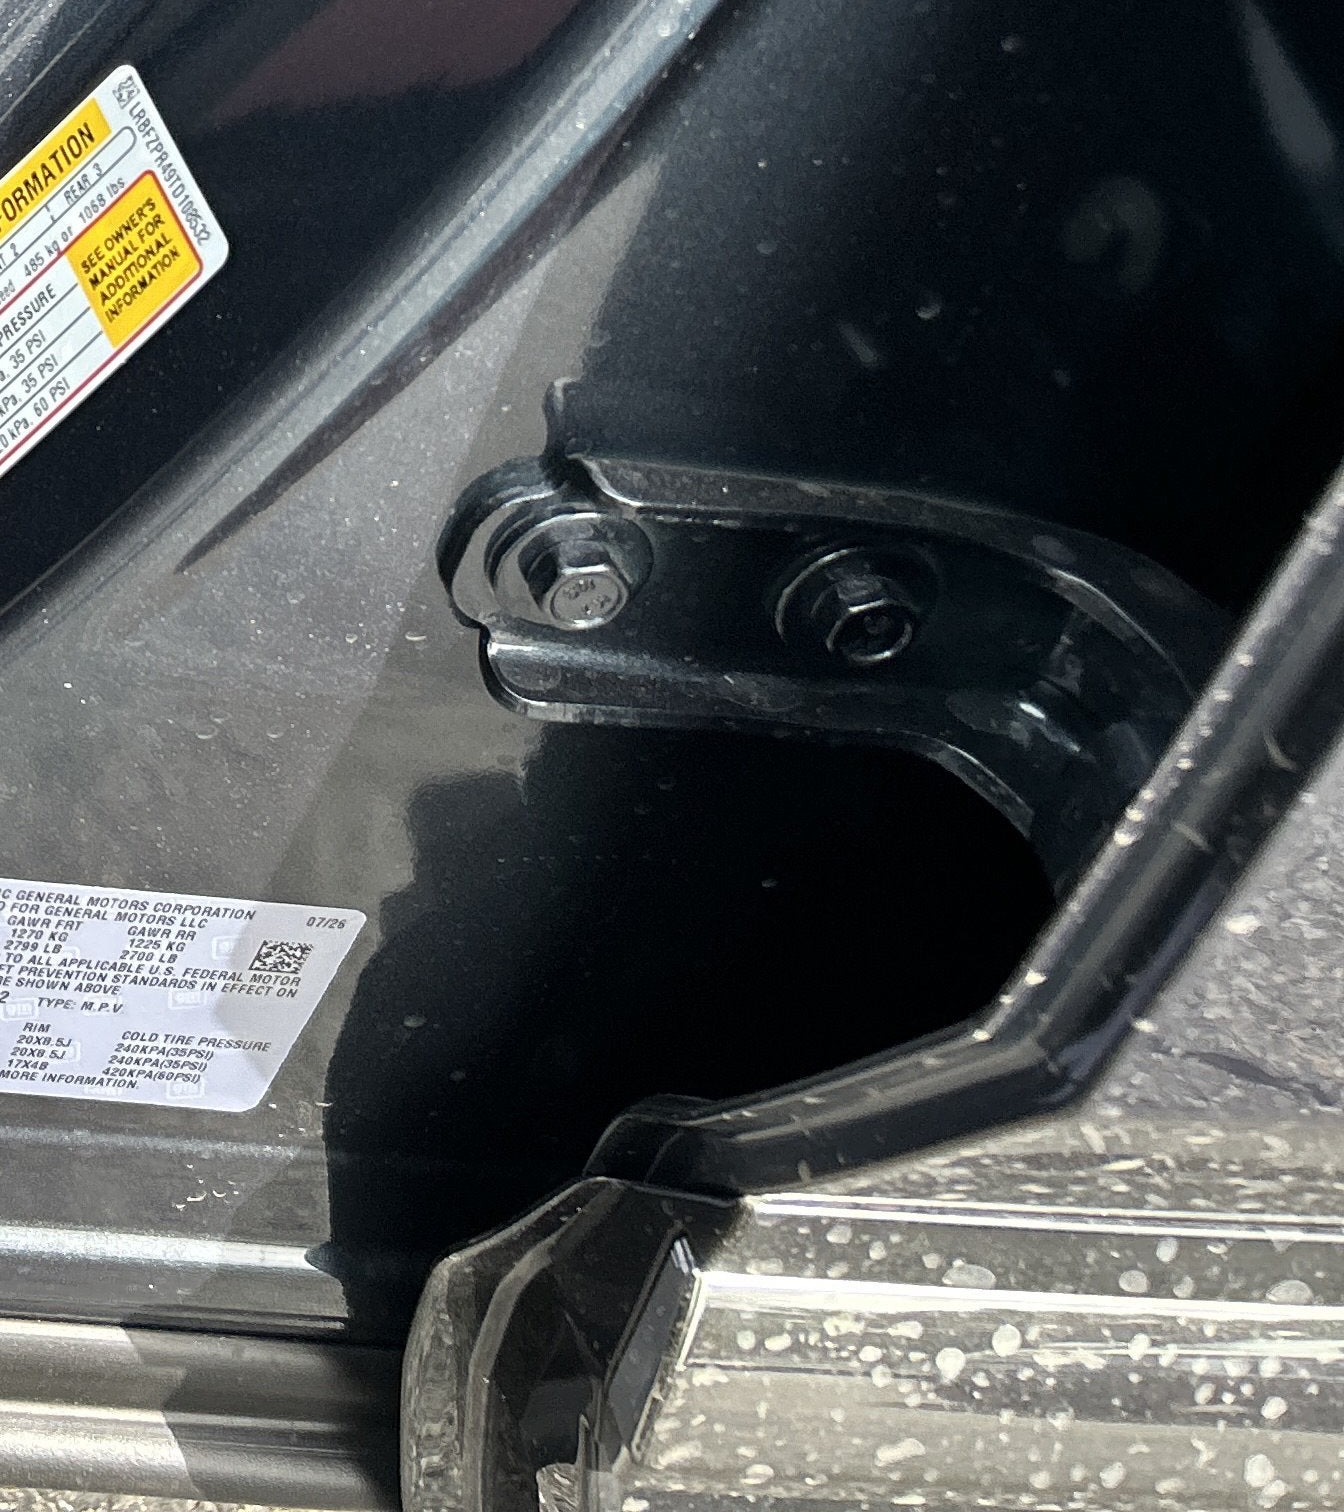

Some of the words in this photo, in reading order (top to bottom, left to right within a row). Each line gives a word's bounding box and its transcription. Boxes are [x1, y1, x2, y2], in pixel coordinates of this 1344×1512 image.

[63, 173, 93, 206] REAR
[92, 162, 105, 180] 3
[24, 252, 45, 277] 485
[44, 240, 63, 257] kg
[60, 226, 73, 243] or
[78, 193, 107, 224] 1068
[105, 177, 125, 198] lbs
[81, 246, 105, 275] SEE
[104, 197, 156, 252] OWNER'S
[9, 242, 21, 259] 2
[88, 240, 139, 291] MANUAL
[137, 213, 166, 244] FOR
[99, 232, 172, 307] ADDITIONAL
[104, 249, 180, 323] INFORMATION
[9, 348, 26, 370] 35
[25, 329, 46, 355] PSI
[21, 372, 38, 394] 35
[37, 354, 59, 379] PSI
[33, 396, 49, 418] 60
[49, 377, 71, 403] PSI
[10, 902, 40, 915] FOR
[44, 905, 108, 921] GENERAL
[113, 911, 177, 927] MOTORS
[179, 916, 209, 929] LLC
[15, 889, 80, 906] GENERAL
[86, 896, 150, 911] MOTORS
[153, 902, 257, 921] CORPORATION
[7, 914, 52, 929] GAWR
[54, 919, 84, 931] FRT
[11, 927, 44, 940] 1270
[47, 931, 69, 942] KG
[127, 925, 172, 939] GAWR
[174, 929, 197, 942] RR
[305, 916, 347, 930] 07/26
[3, 939, 39, 952] 2799
[43, 942, 63, 954] LB
[119, 949, 155, 962] 2700
[158, 953, 178, 964] LB
[129, 938, 162, 950] 1225
[165, 940, 186, 952] KG
[5, 951, 24, 964] TO
[26, 954, 53, 967] ALL
[57, 958, 145, 974] APPLICABLE
[182, 967, 244, 983] FEDERAL
[248, 973, 302, 987] MOTOR
[17, 965, 108, 983] PREVENTION
[111, 973, 198, 990] STANDARDS
[200, 981, 218, 992] IN
[220, 982, 274, 996] EFFECT
[276, 987, 298, 998] ON
[15, 977, 71, 991] SHOWN
[37, 996, 78, 1010] TYPE:
[22, 1022, 51, 1033] RIM
[121, 1030, 160, 1043] COLD
[163, 1033, 196, 1046] TIRE
[197, 1036, 272, 1053] PRESSURE
